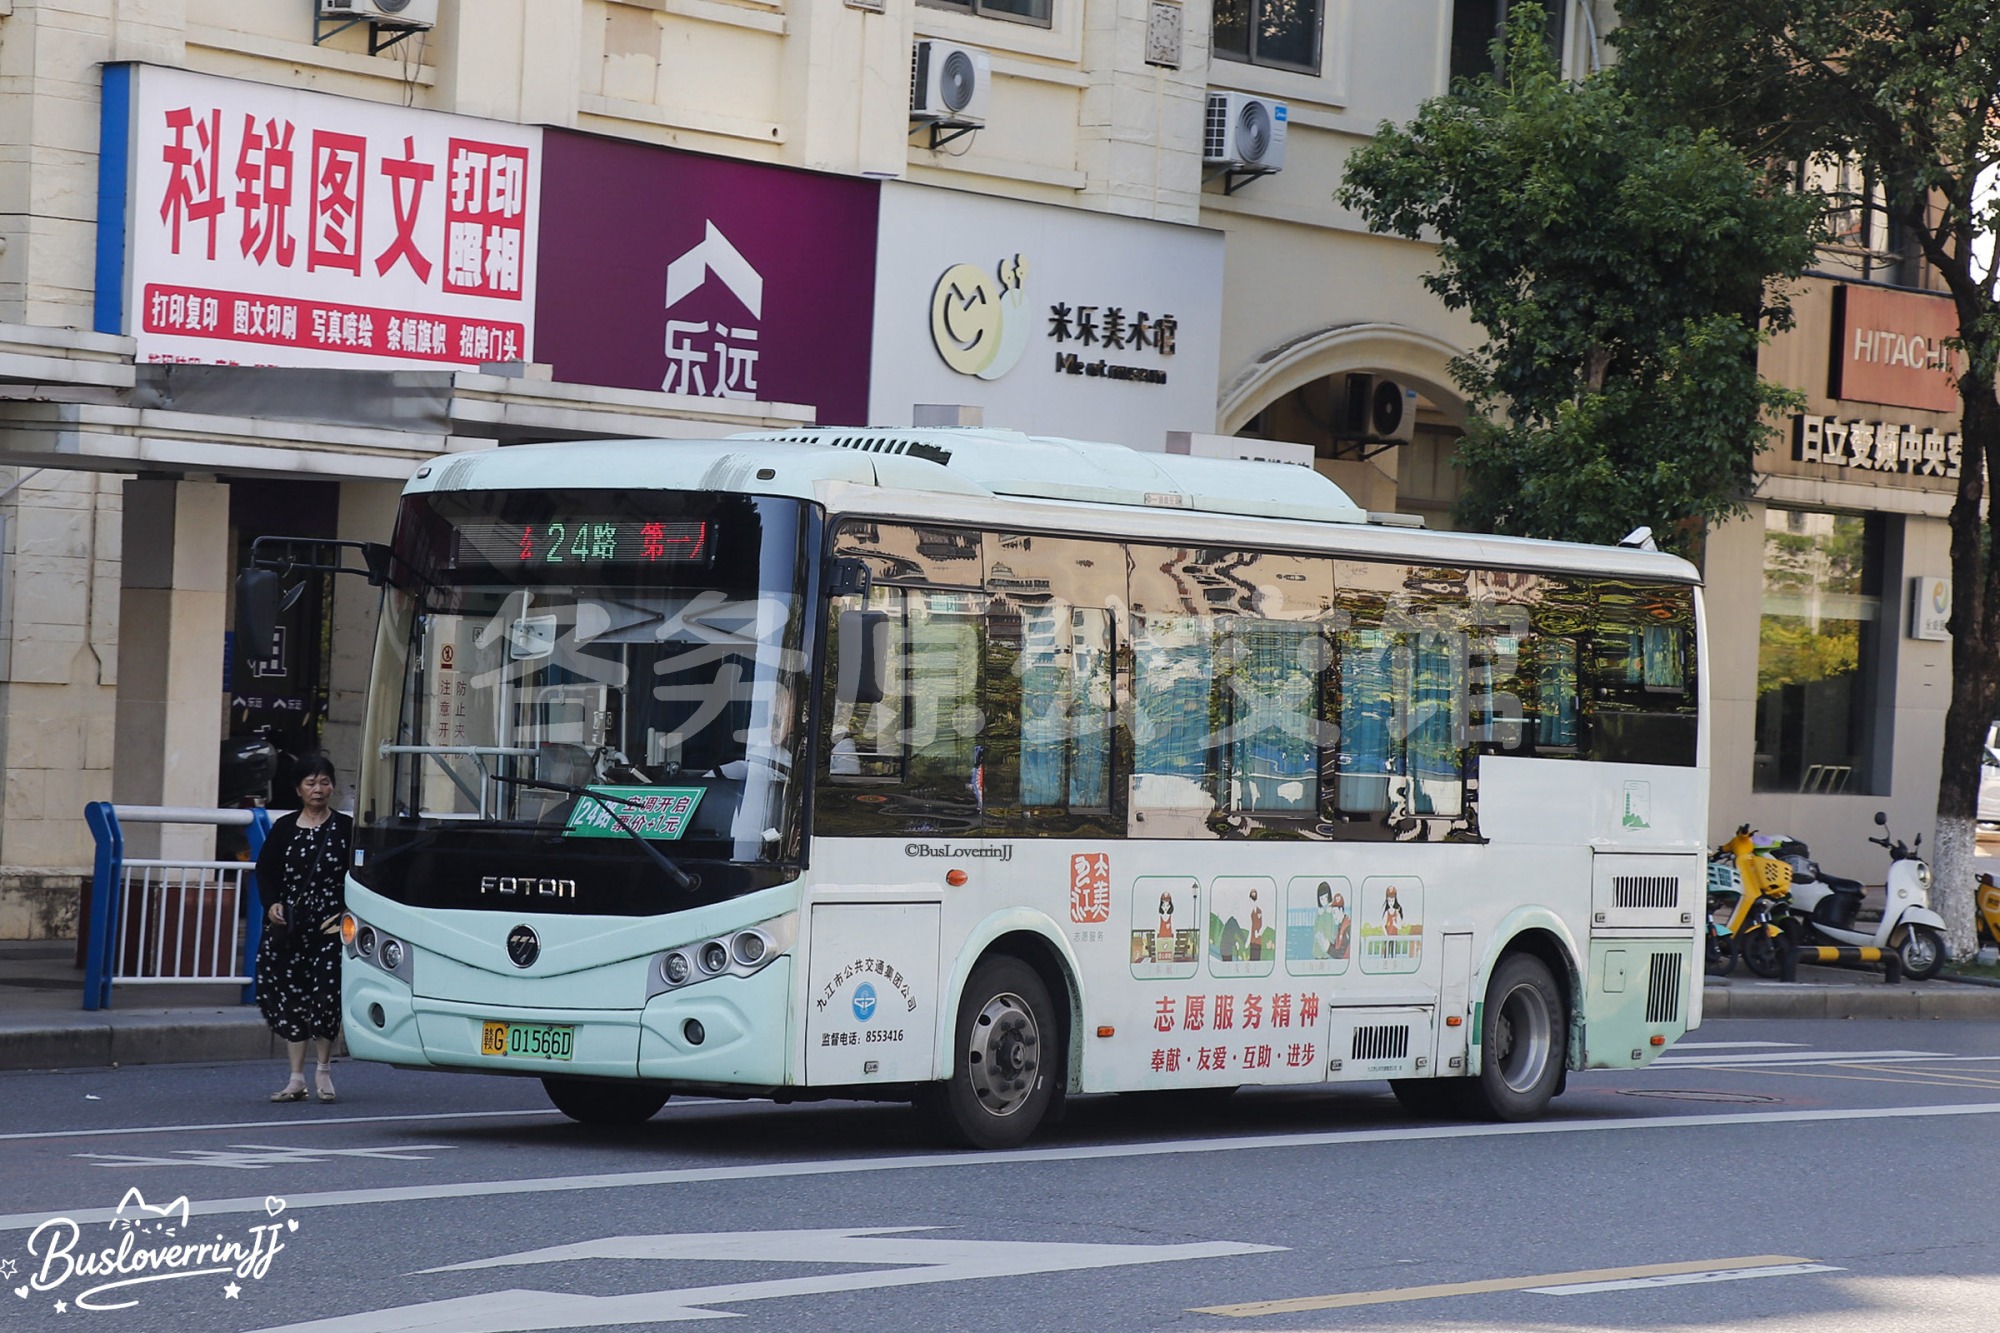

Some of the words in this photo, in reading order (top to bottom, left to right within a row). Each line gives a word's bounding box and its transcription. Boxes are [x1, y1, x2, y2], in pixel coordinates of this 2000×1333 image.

[159, 106, 436, 285] 科锐图文
[450, 147, 524, 219] 打印
[446, 221, 521, 291] 照相
[151, 291, 219, 331] 打印复印
[232, 299, 298, 340] 图文印刷
[311, 309, 373, 349] 写真喷绘
[386, 316, 447, 355] 条幅旗帜
[459, 324, 518, 361] 招牌门头
[1048, 302, 1178, 355] 米乐美术馆
[1853, 327, 1949, 373] HITACHI
[661, 319, 759, 401] 乐远
[546, 521, 617, 562] 24路
[611, 814, 681, 833] 票价+1元
[622, 796, 691, 814] 空调开启
[480, 876, 576, 898] FOTON
[816, 957, 917, 1012] 九江市公共交通集团公司
[1153, 992, 1320, 1032] 志愿服务精神
